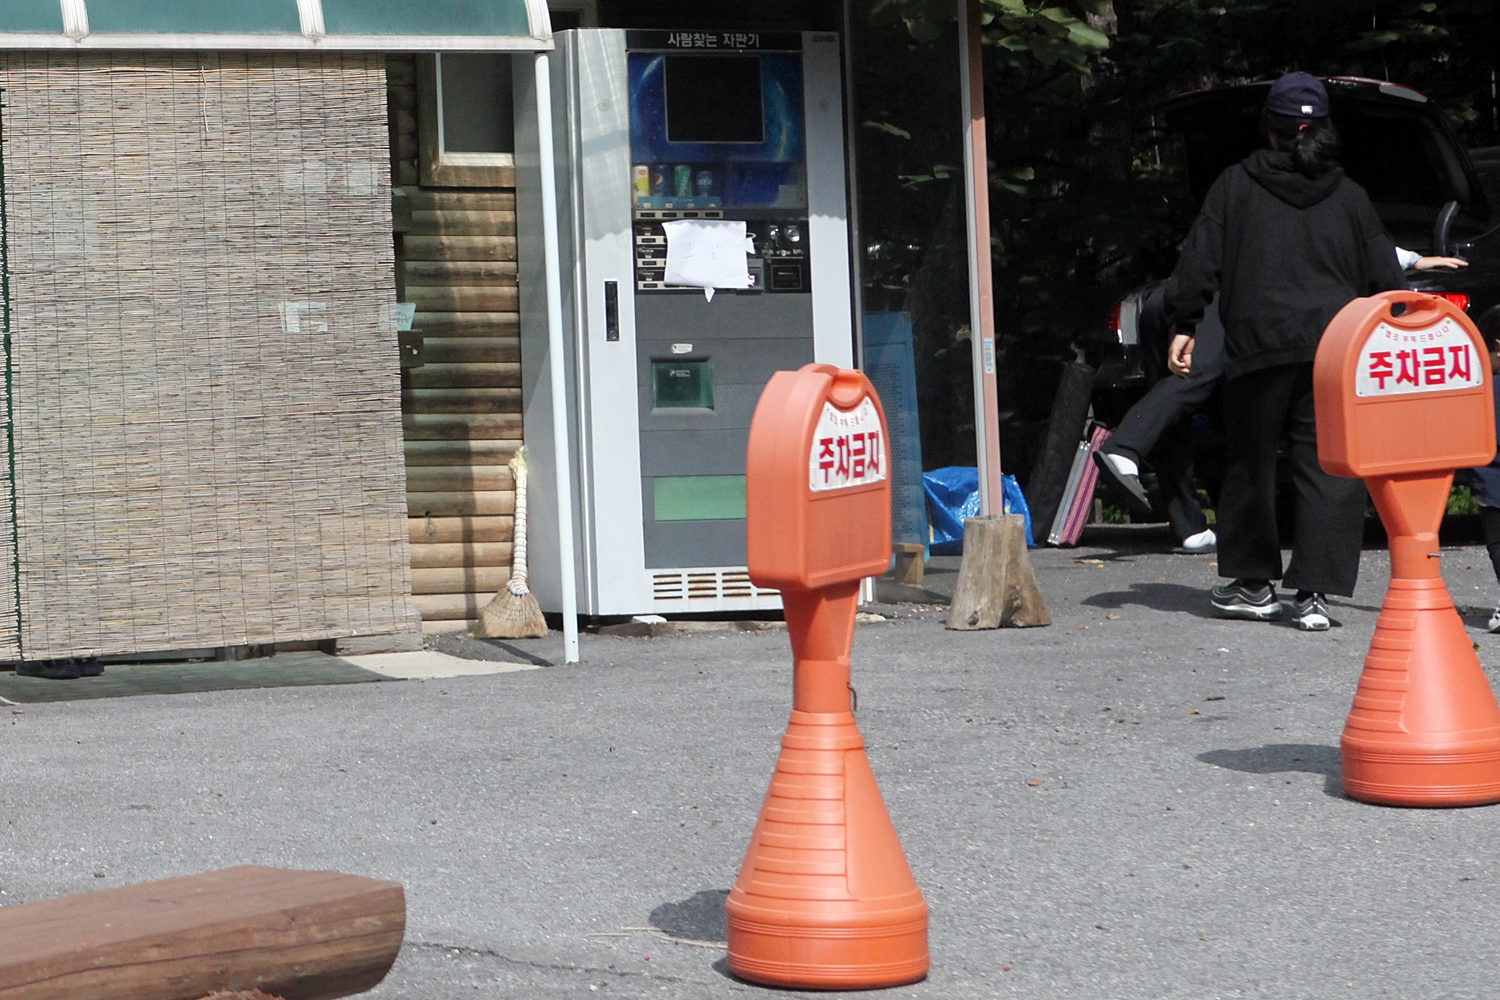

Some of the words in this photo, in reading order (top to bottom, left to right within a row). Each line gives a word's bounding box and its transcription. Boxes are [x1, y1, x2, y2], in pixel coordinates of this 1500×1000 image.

[667, 32, 718, 48] 사람찾는
[722, 33, 761, 49] 자판기
[1368, 344, 1472, 390] 주차금지
[818, 429, 880, 484] 주차금지
